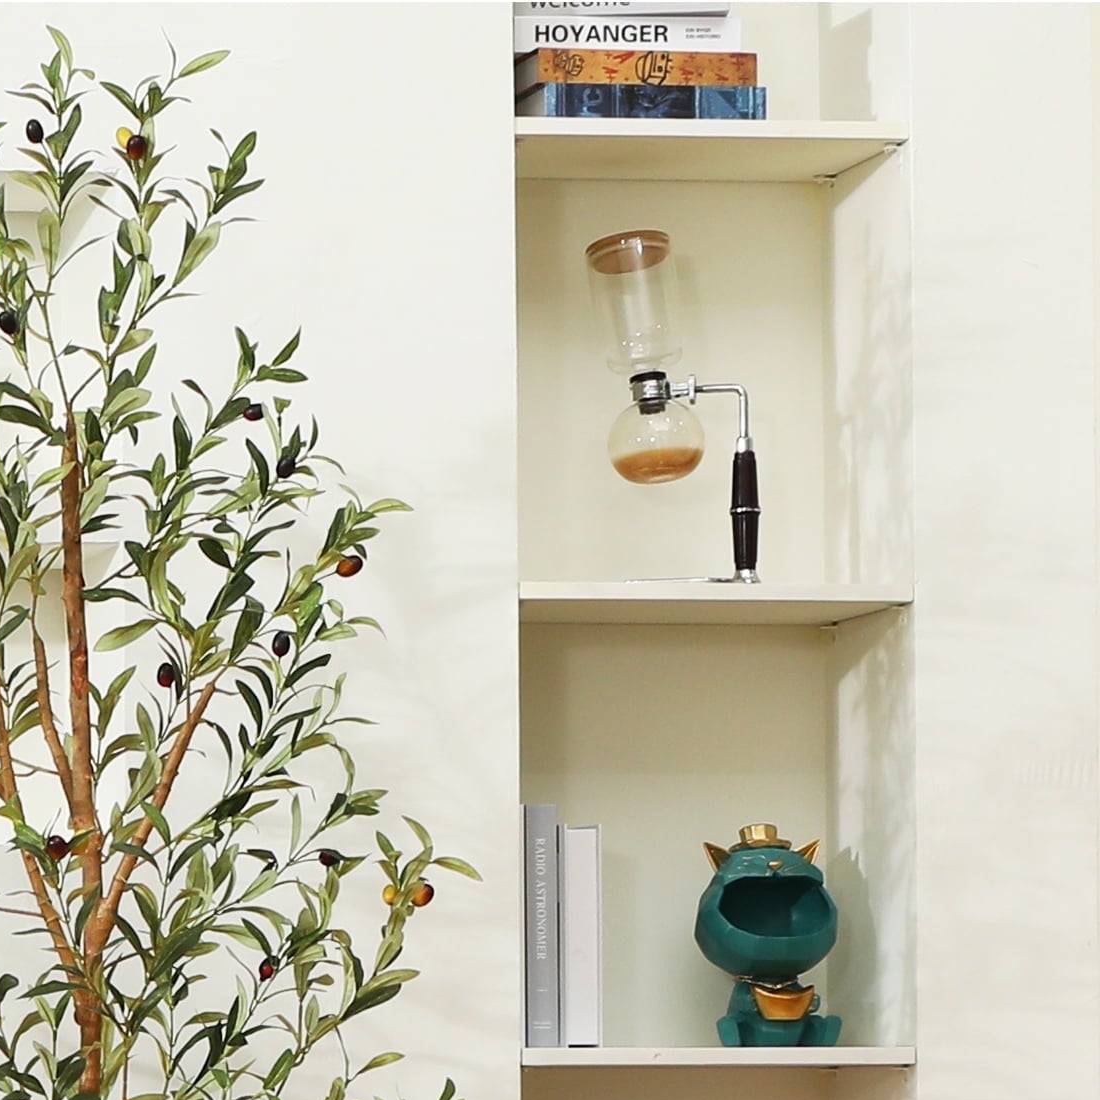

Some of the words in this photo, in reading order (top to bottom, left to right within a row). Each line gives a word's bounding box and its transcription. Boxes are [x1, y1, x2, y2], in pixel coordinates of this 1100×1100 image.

[534, 24, 669, 43] HOYANGER
[535, 837, 546, 876] RADIO
[536, 880, 547, 960] ASTRONOMER
